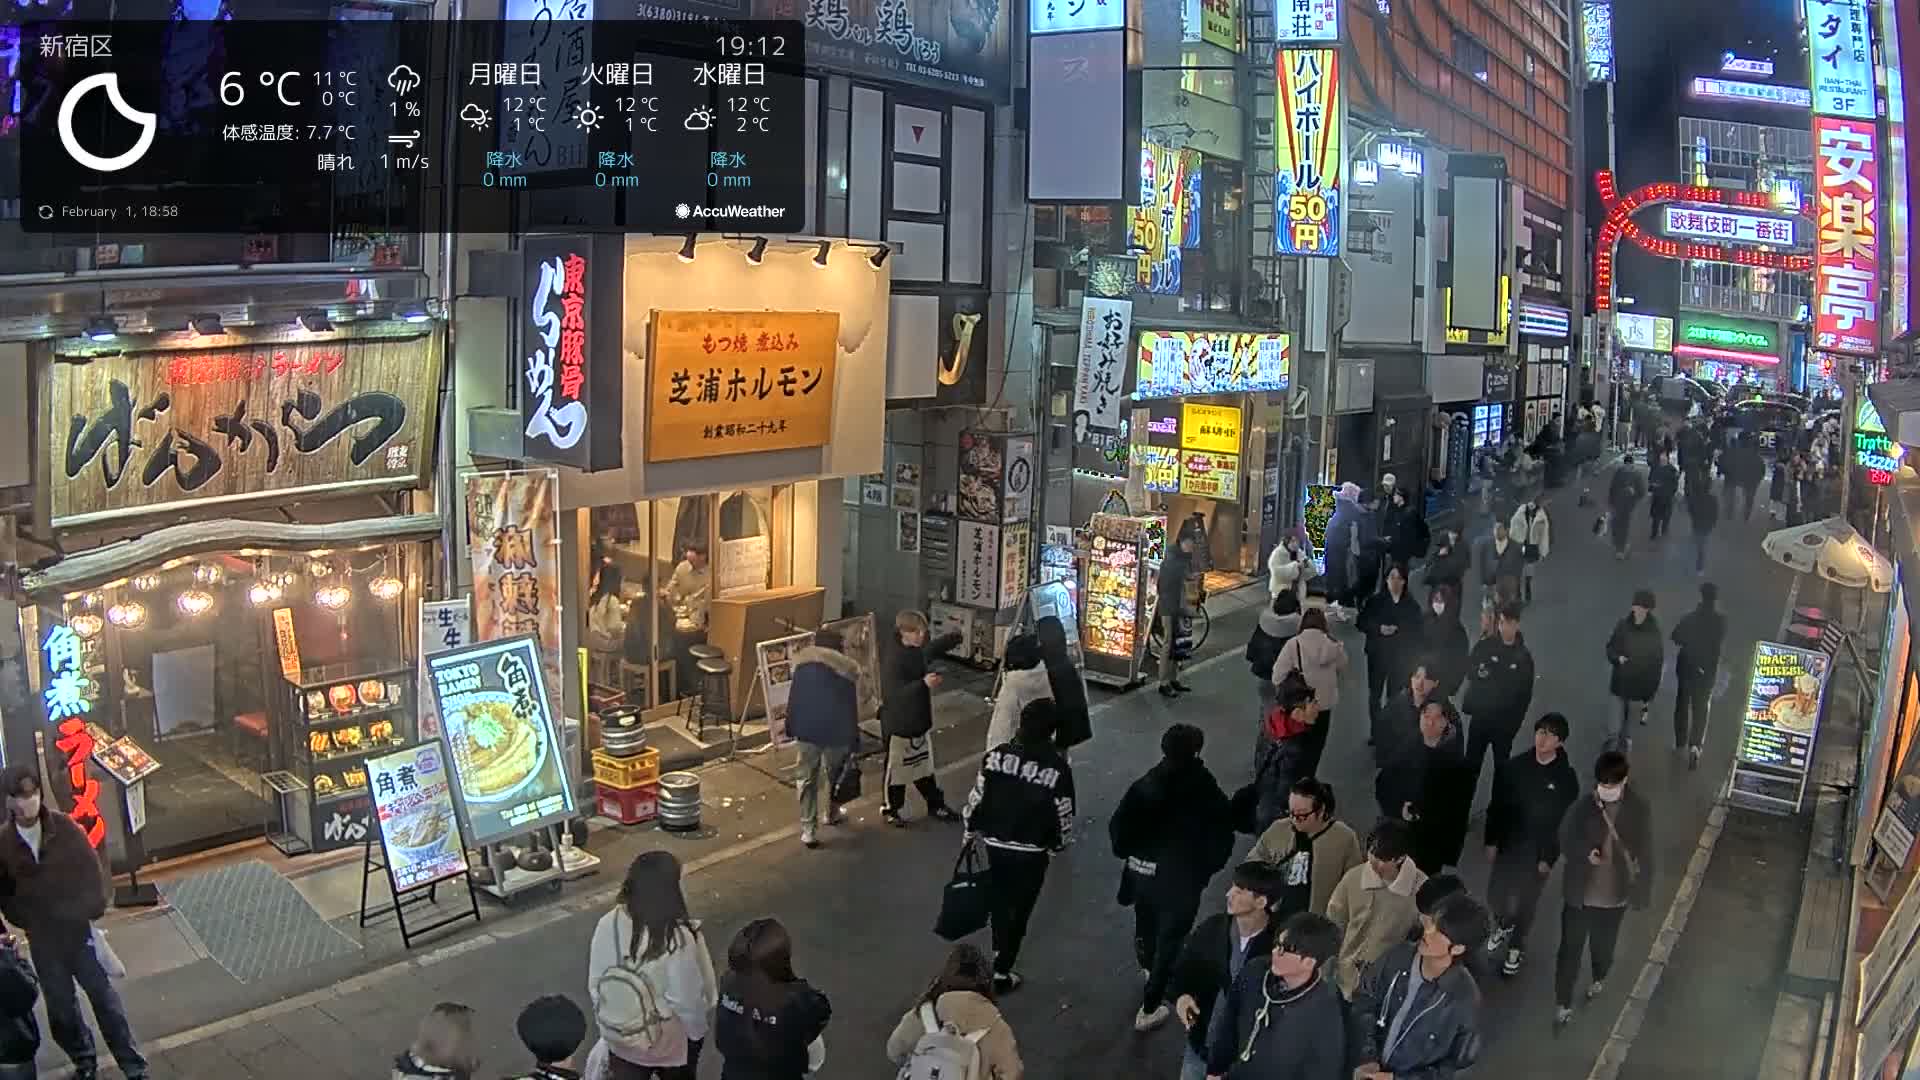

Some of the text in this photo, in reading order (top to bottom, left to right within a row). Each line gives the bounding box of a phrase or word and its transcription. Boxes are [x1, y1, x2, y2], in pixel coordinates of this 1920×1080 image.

[1294, 54, 1321, 189] ハイボール
[1832, 97, 1856, 111] 3F
[1289, 194, 1328, 221] 50
[1295, 222, 1321, 252] 円
[1669, 210, 1790, 244] 歌舞伎町一番街
[1819, 123, 1876, 330] 安楽亭
[561, 254, 587, 401] 東京豚骨
[1094, 307, 1124, 416] お好み焼き
[669, 366, 824, 405] 芝浦ホルモン
[375, 764, 419, 797] 角煮
